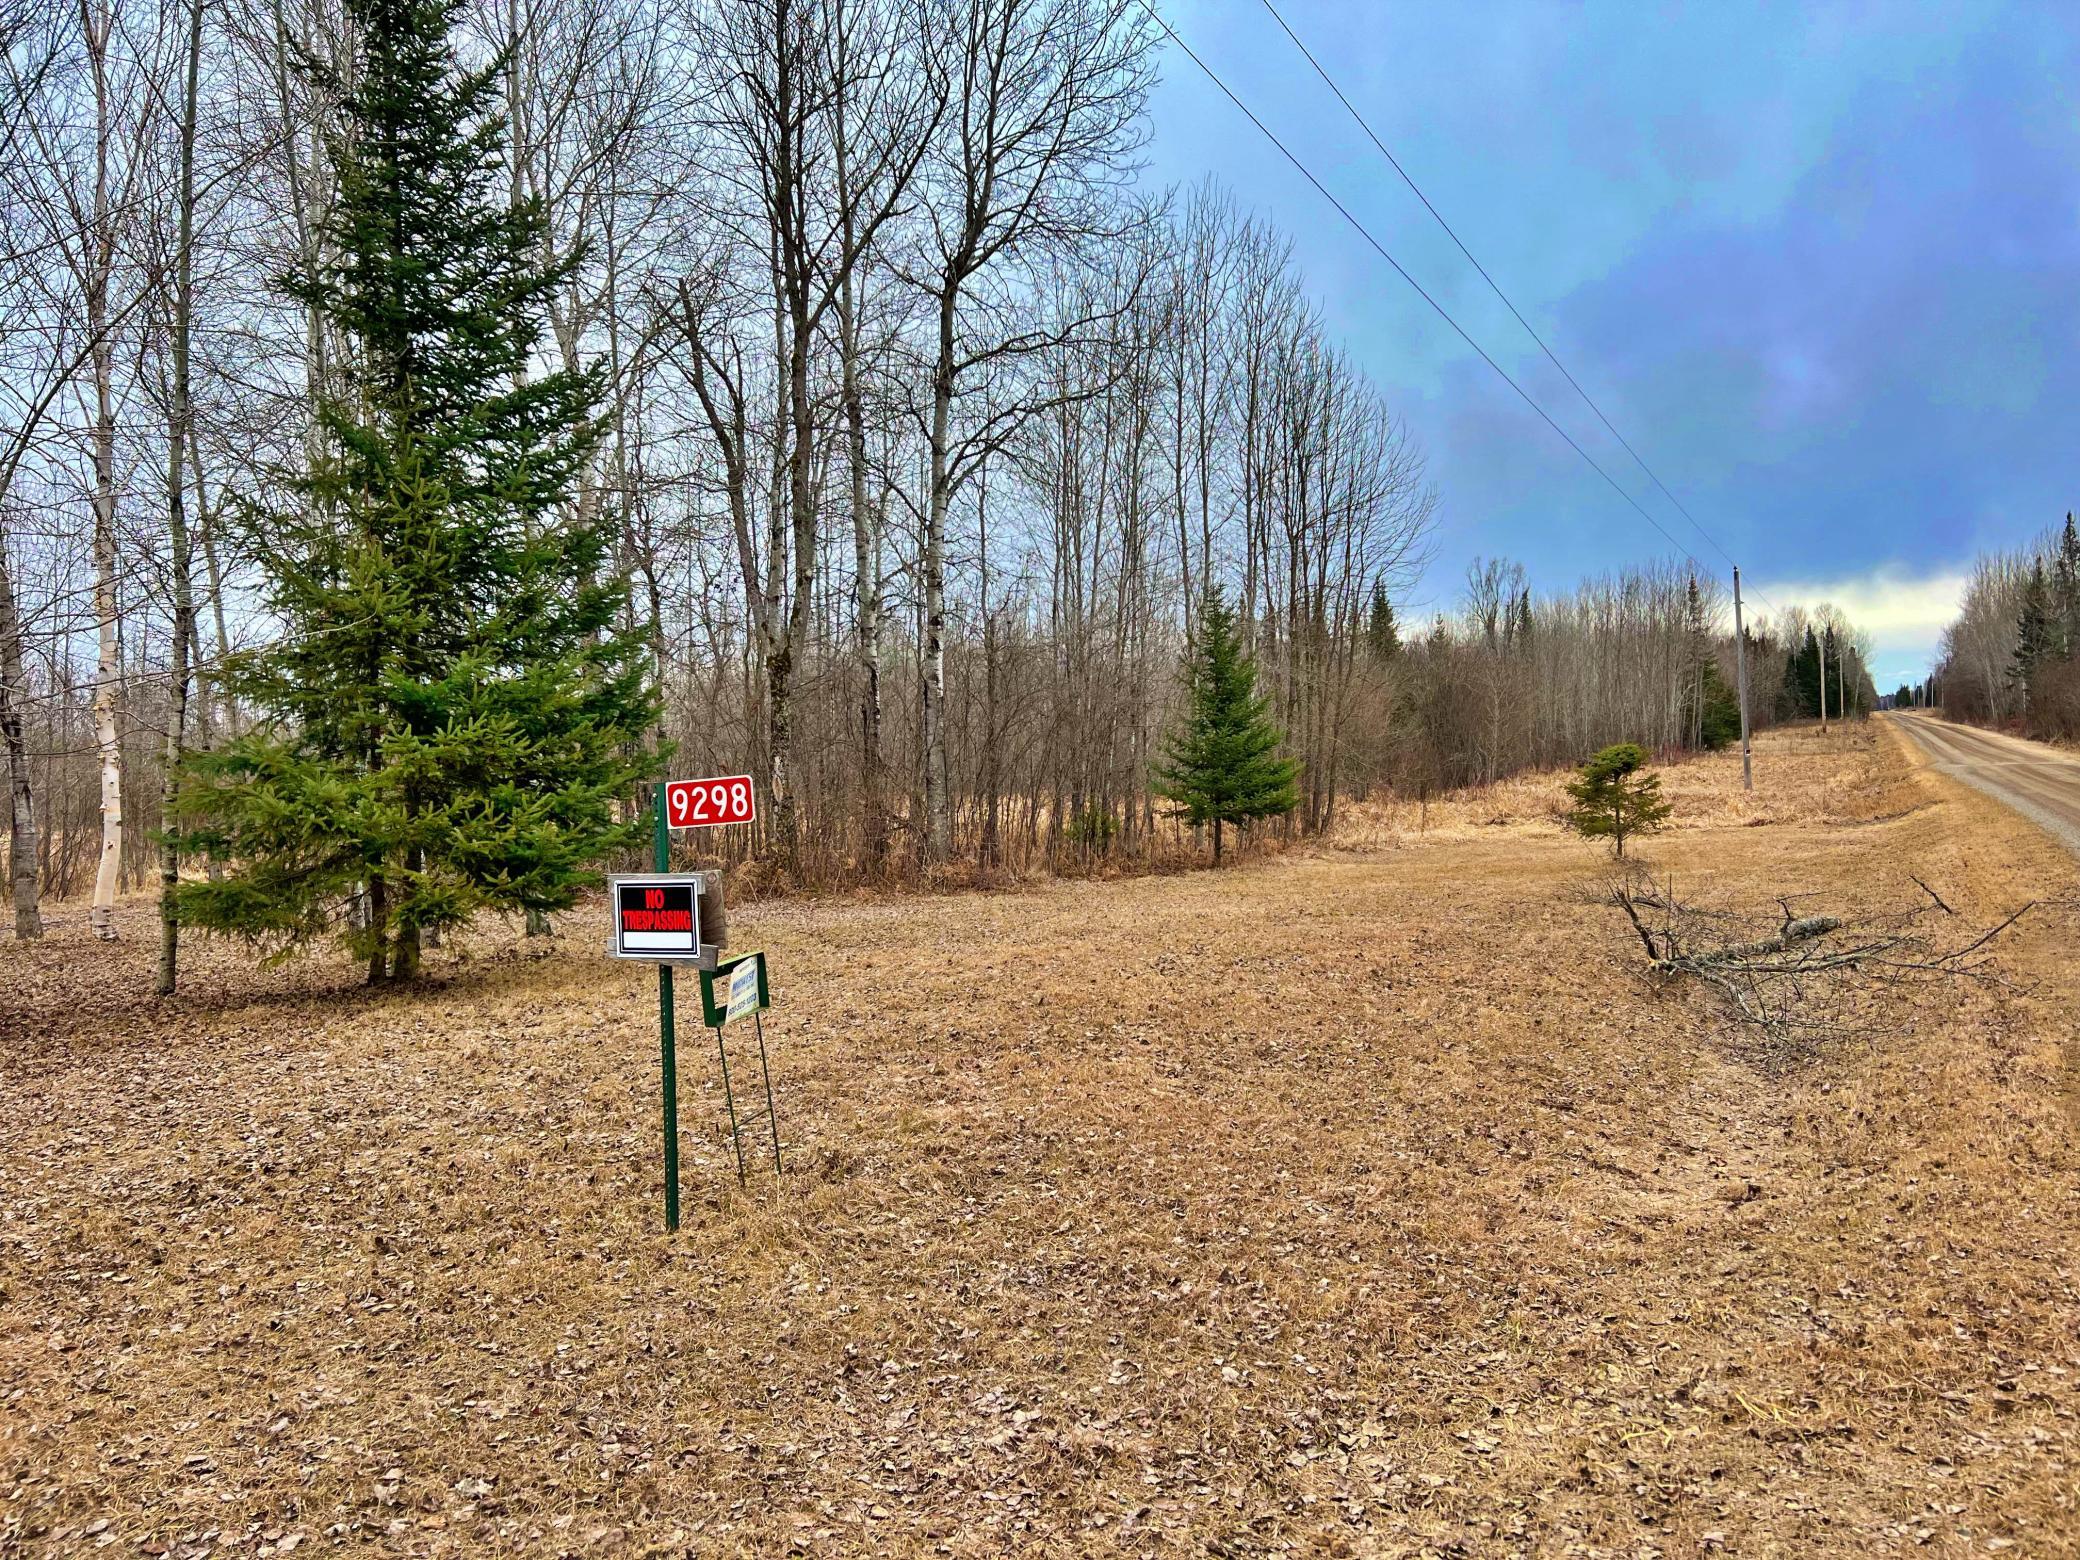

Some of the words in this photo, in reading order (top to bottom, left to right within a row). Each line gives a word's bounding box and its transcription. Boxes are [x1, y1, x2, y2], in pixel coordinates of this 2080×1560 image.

[672, 783, 748, 821] 9298
[645, 889, 665, 909] NO
[623, 910, 692, 930] TRESPASSING
